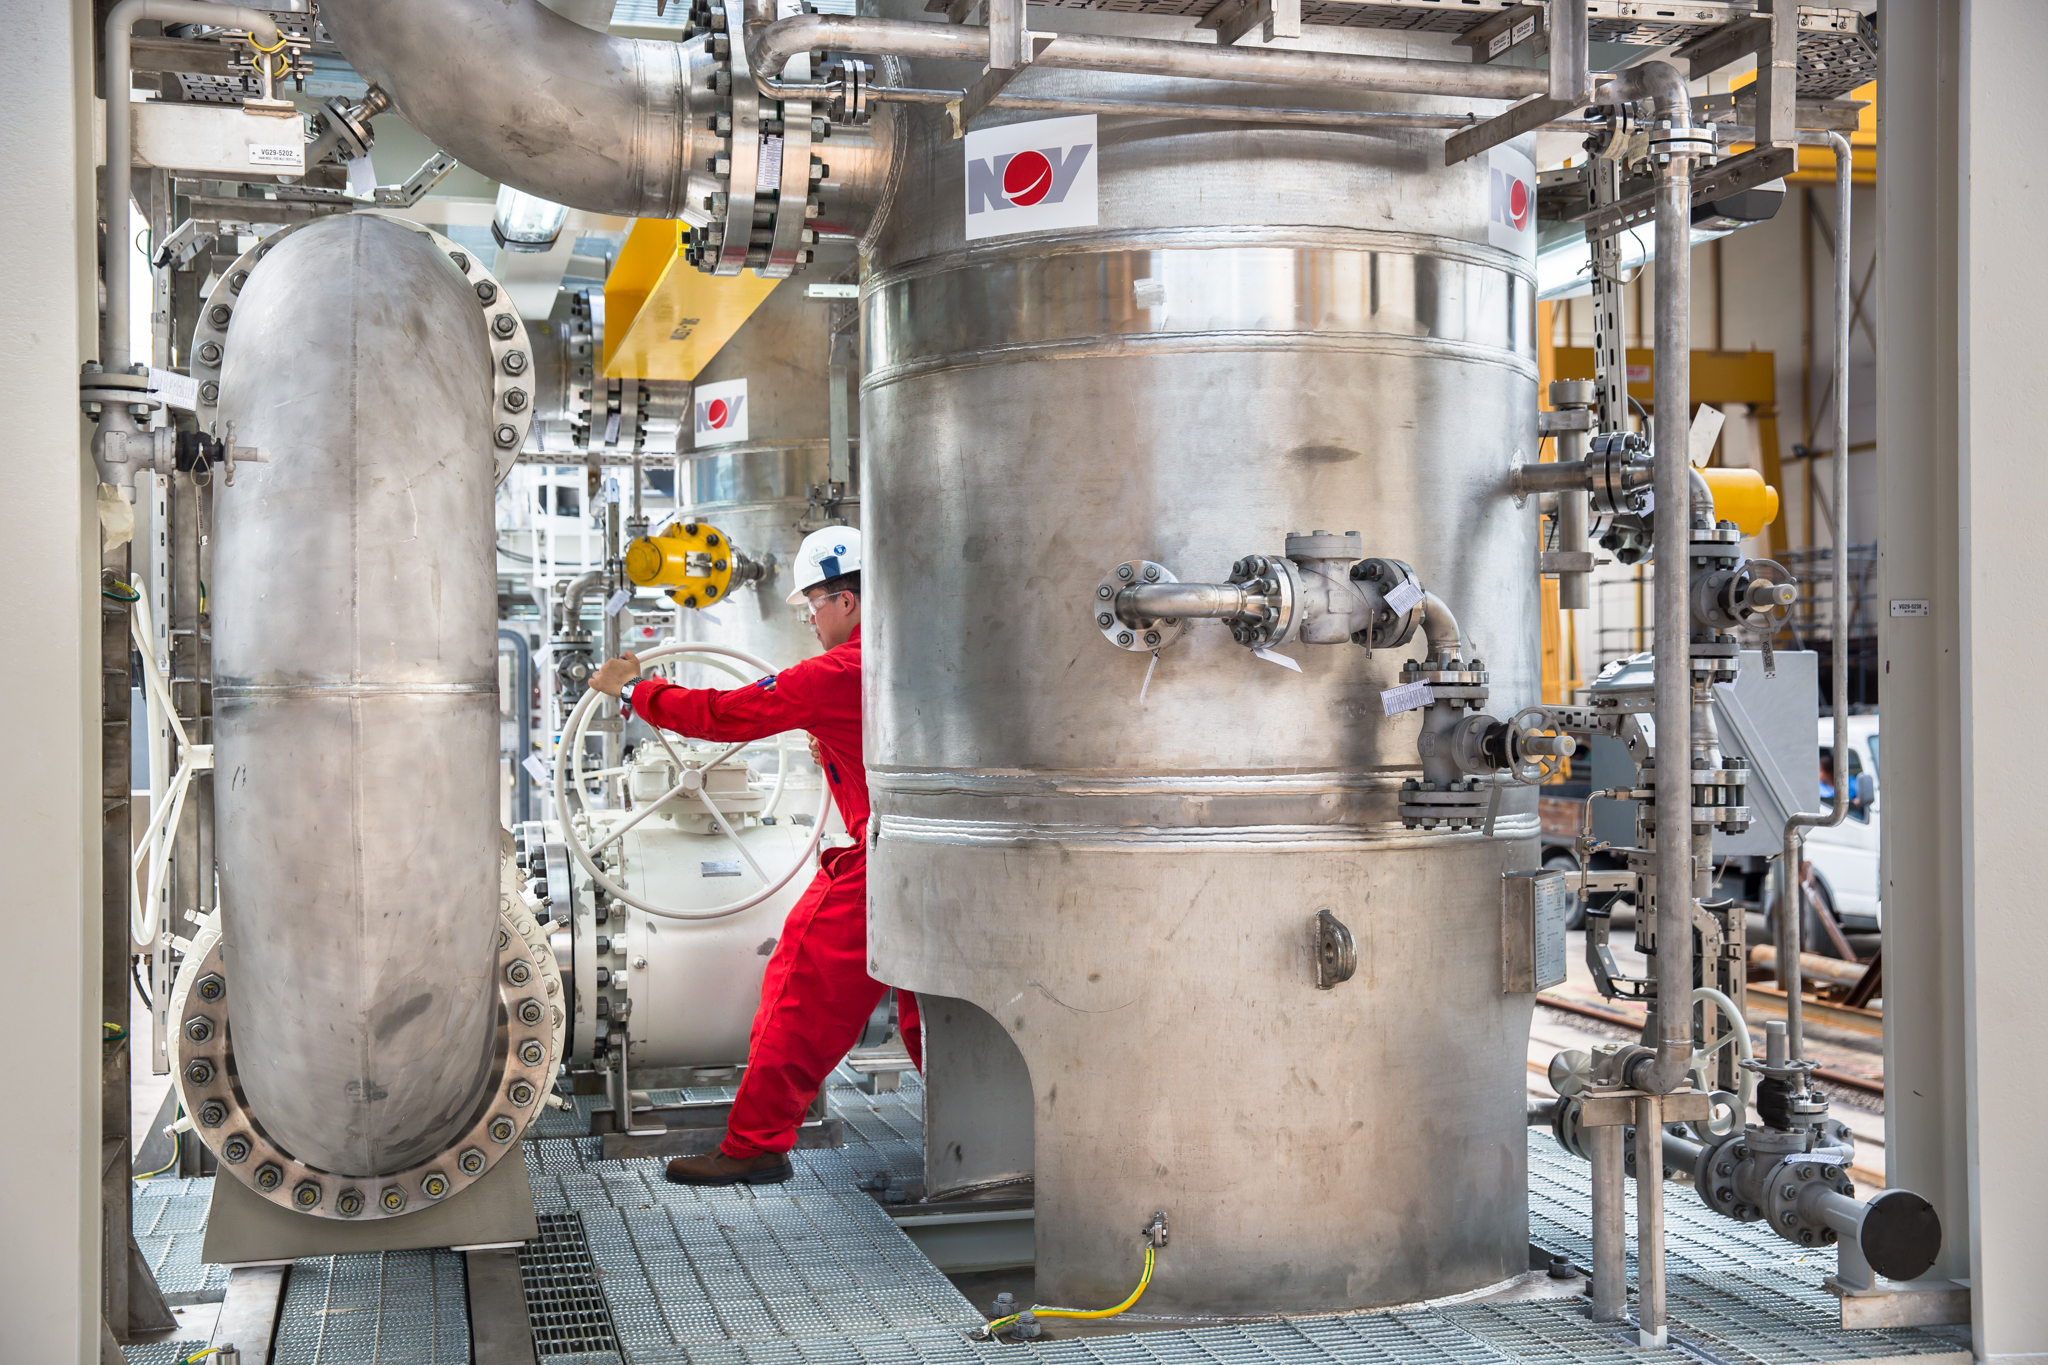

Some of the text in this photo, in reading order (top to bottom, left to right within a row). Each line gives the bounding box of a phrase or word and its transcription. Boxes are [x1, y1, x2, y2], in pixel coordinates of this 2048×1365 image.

[260, 148, 293, 157] VG29-5202
[968, 143, 1093, 215] NOV
[1491, 167, 1535, 230] NOV
[696, 395, 744, 434] NOV
